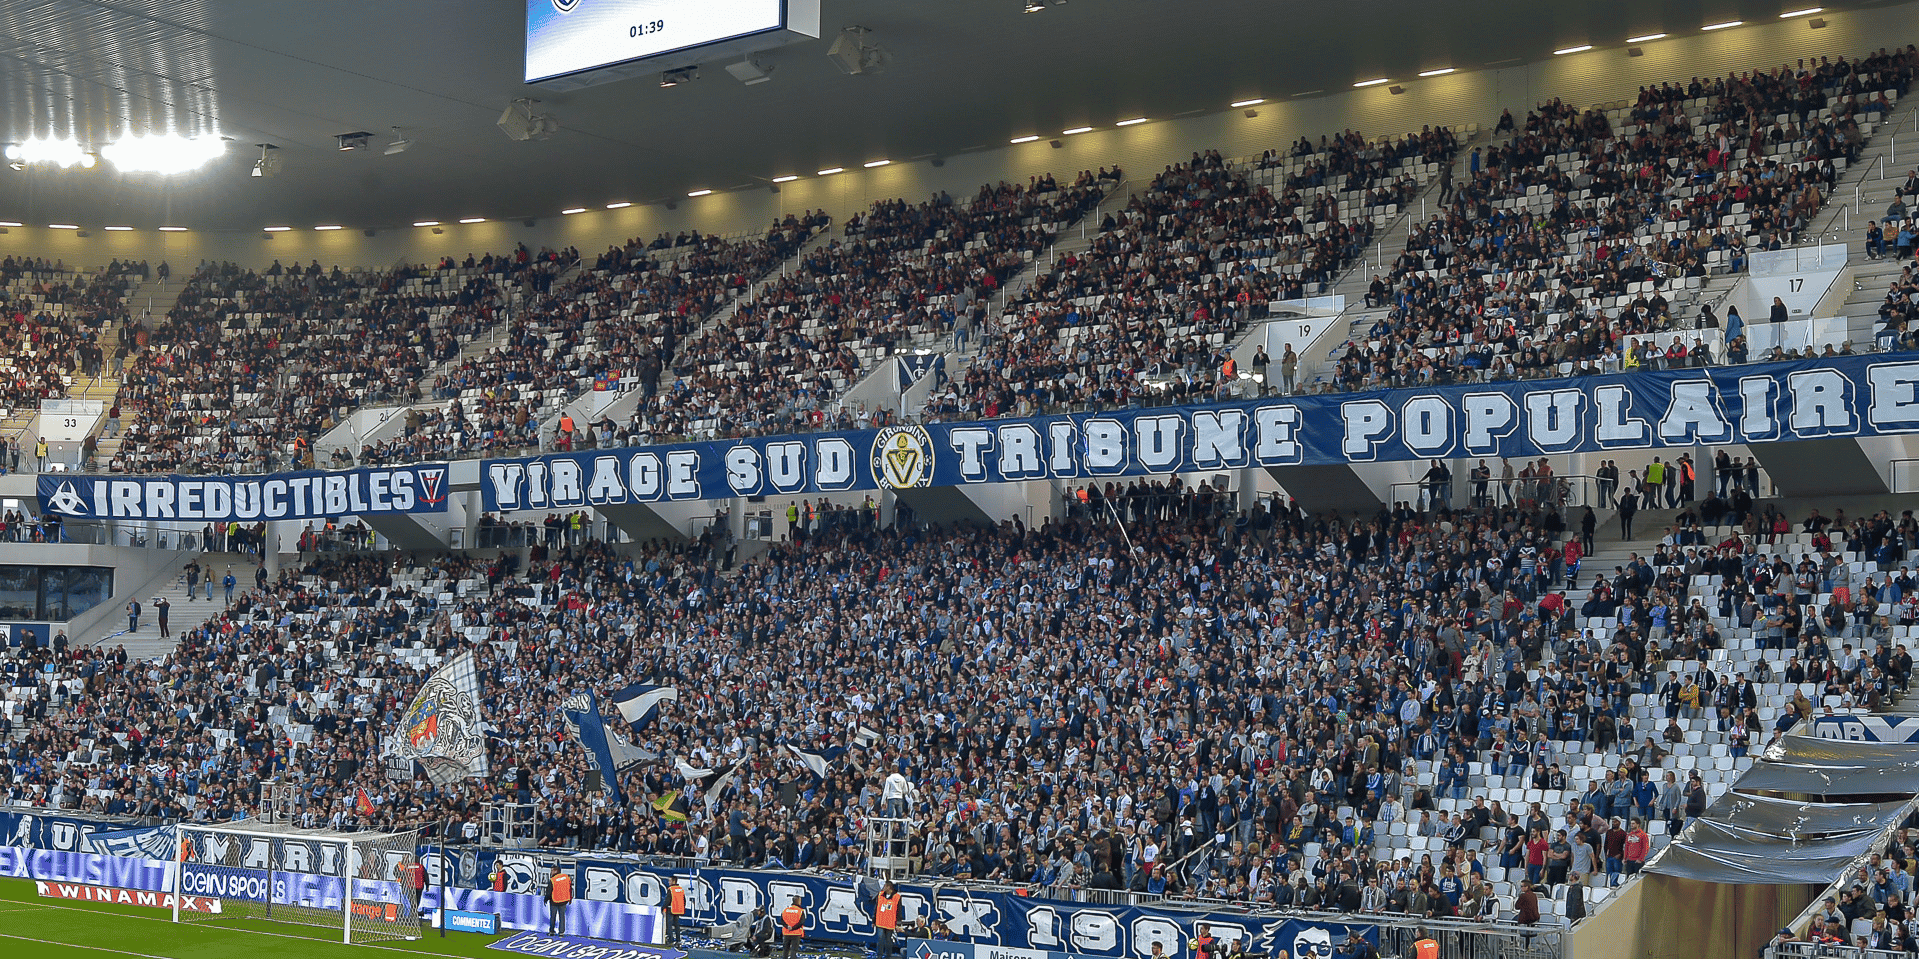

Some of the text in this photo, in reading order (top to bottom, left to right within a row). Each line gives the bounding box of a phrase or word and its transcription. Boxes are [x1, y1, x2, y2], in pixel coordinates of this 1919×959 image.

[629, 20, 664, 38] 01:39
[1789, 278, 1804, 293] 17
[1299, 324, 1311, 338] 19
[64, 418, 77, 428] 33
[950, 361, 1919, 483] TRIBUNE POPULAIRE
[488, 437, 857, 511] VIRAGE SUD
[94, 471, 415, 518] IRREDUCTIBLES
[183, 864, 227, 896] beIN
[229, 875, 286, 900] SPORS
[58, 883, 199, 911] WINAMAX
[452, 914, 492, 929] COMMENTEZ
